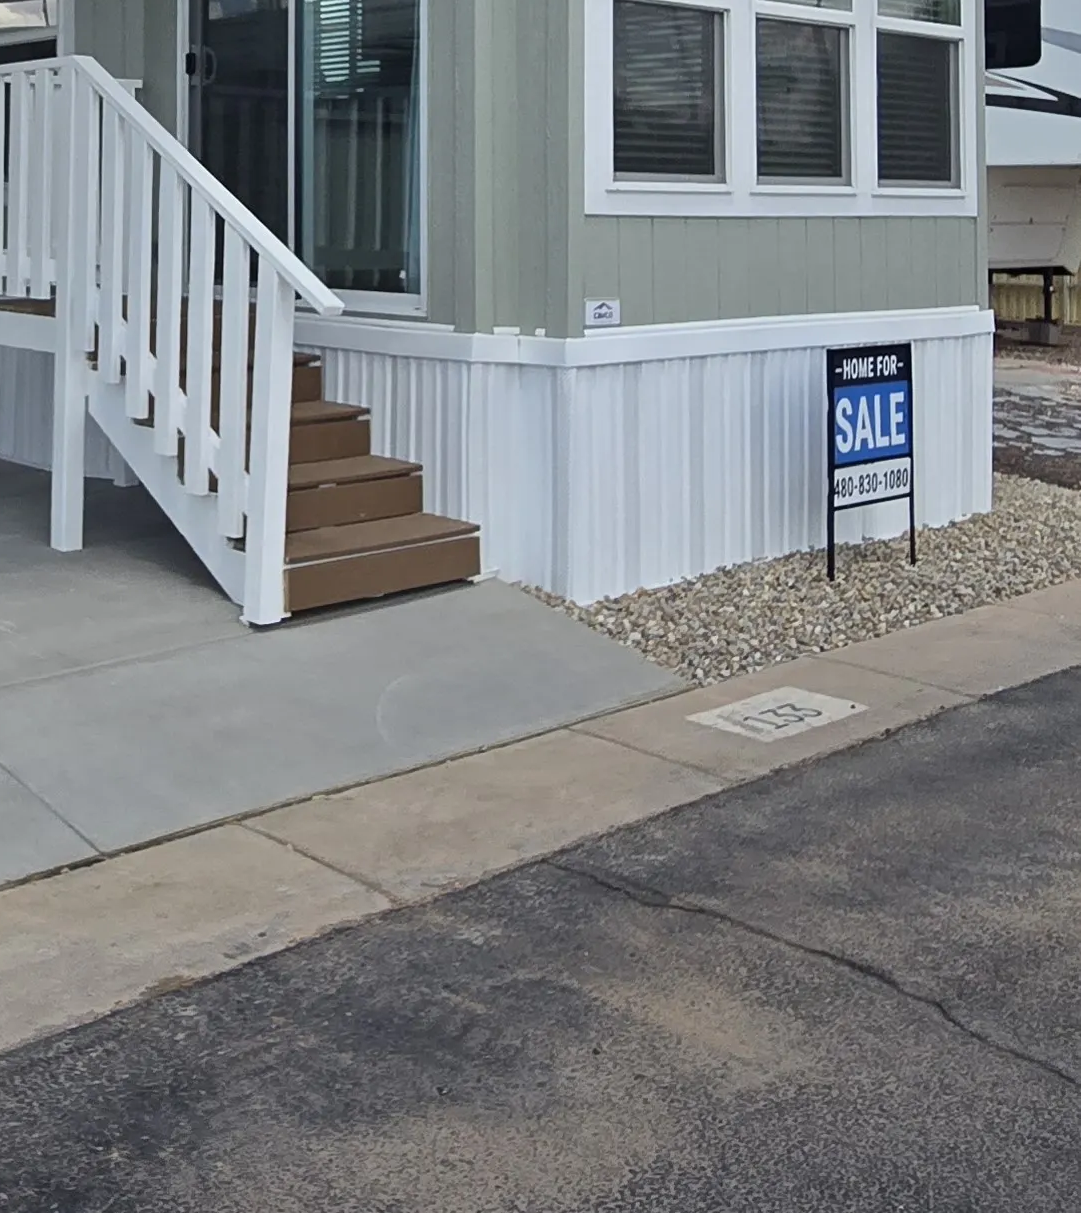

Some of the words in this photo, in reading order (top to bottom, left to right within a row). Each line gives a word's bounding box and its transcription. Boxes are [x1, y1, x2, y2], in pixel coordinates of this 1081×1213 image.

[835, 391, 906, 454] SALE
[834, 468, 908, 499] 480-830-1080
[743, 702, 823, 729] 133
